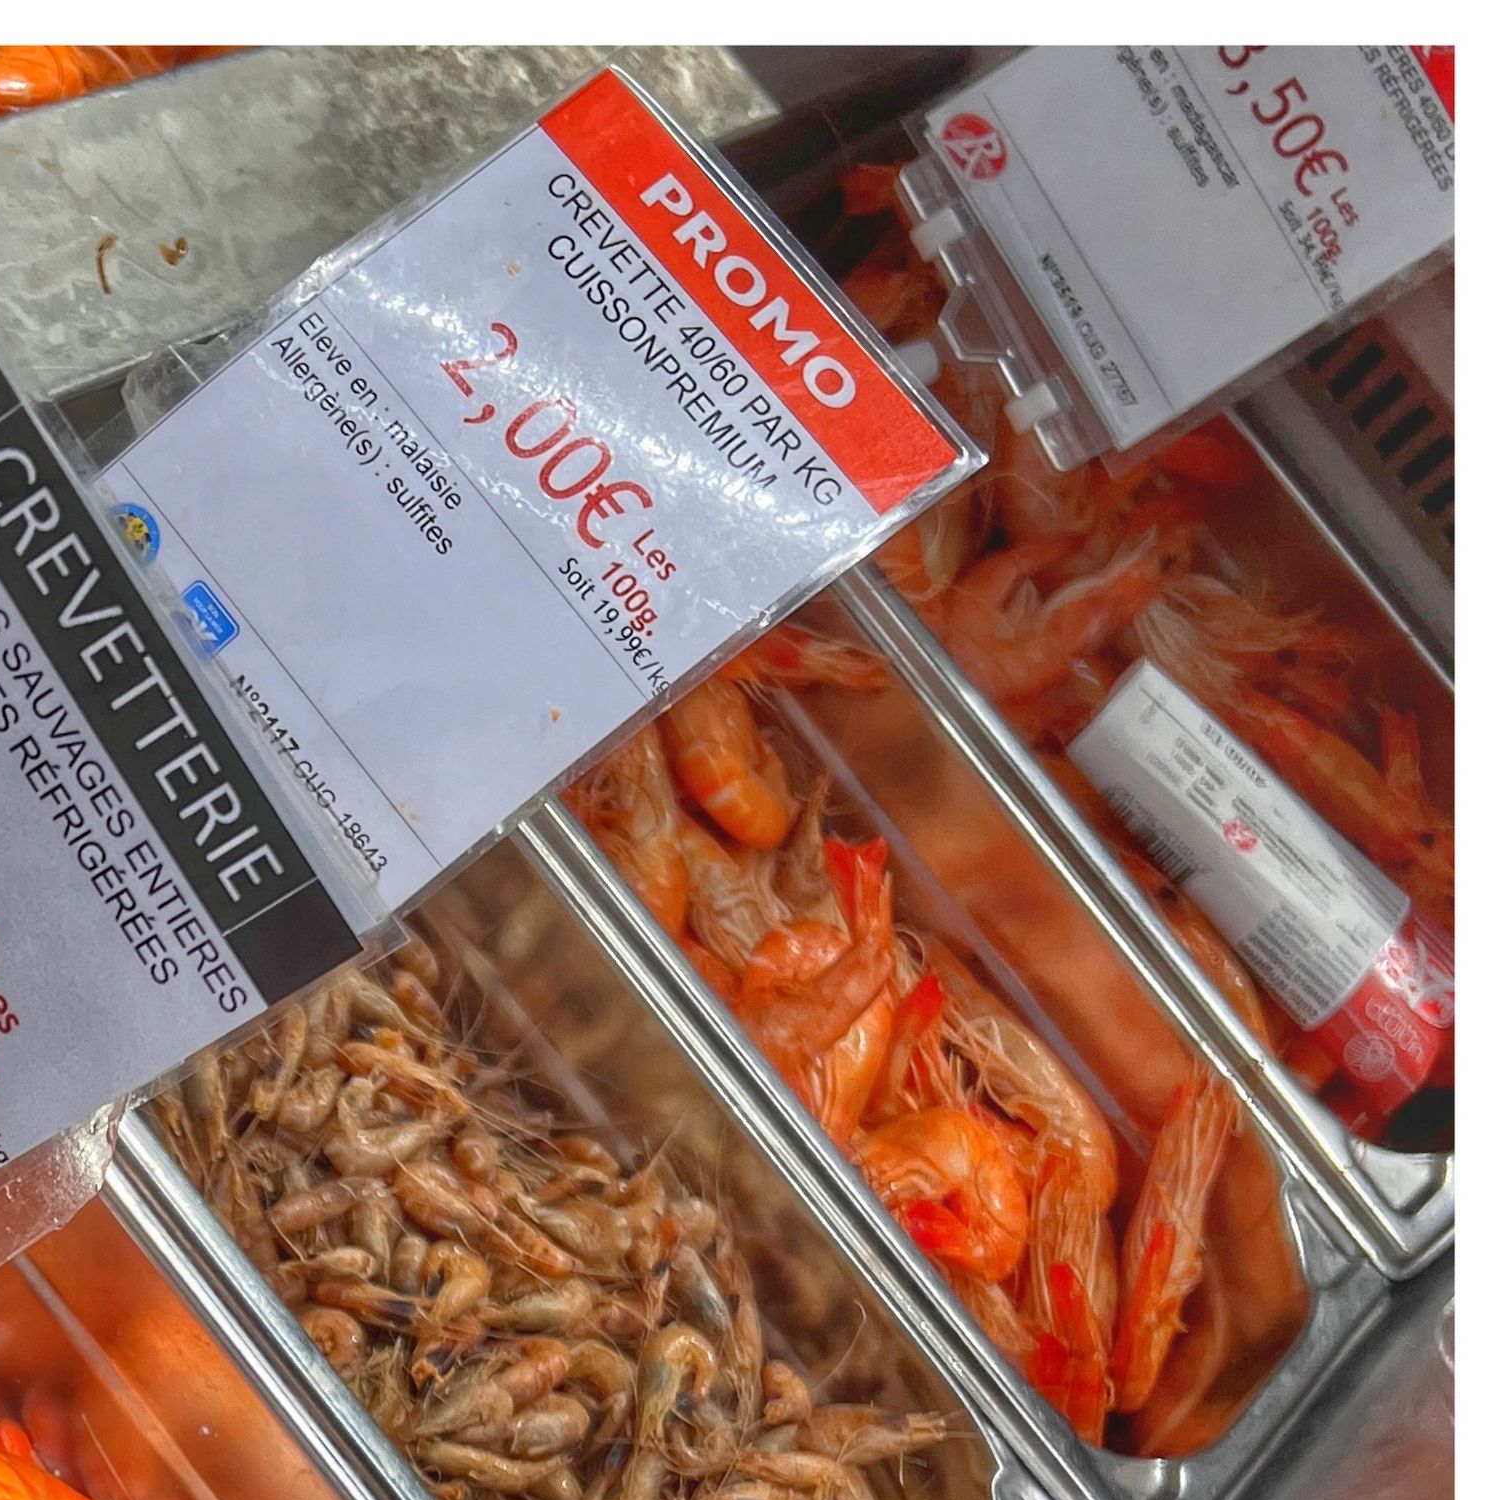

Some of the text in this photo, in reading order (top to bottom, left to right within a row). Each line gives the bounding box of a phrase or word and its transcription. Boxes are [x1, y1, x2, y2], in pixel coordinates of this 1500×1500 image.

[639, 172, 855, 407] PROMO
[1331, 188, 1356, 225] Les
[270, 336, 382, 465] Allergène(s)
[387, 477, 452, 554] sulfites
[298, 312, 351, 375] Eleve
[350, 377, 377, 407] en
[384, 420, 461, 509] malaisie
[442, 322, 653, 550] 2,00€
[547, 234, 777, 486] CUISSONPREMIUM
[548, 173, 841, 504] CREVETTE 40/60 PAR KG
[558, 557, 595, 600] Soit
[602, 561, 657, 638] 100g.
[631, 528, 676, 581] Les
[2, 642, 134, 837] SAUVAGES
[124, 839, 247, 1012] ENTIERES
[8, 734, 178, 984] RÉFRIGÉRÉES
